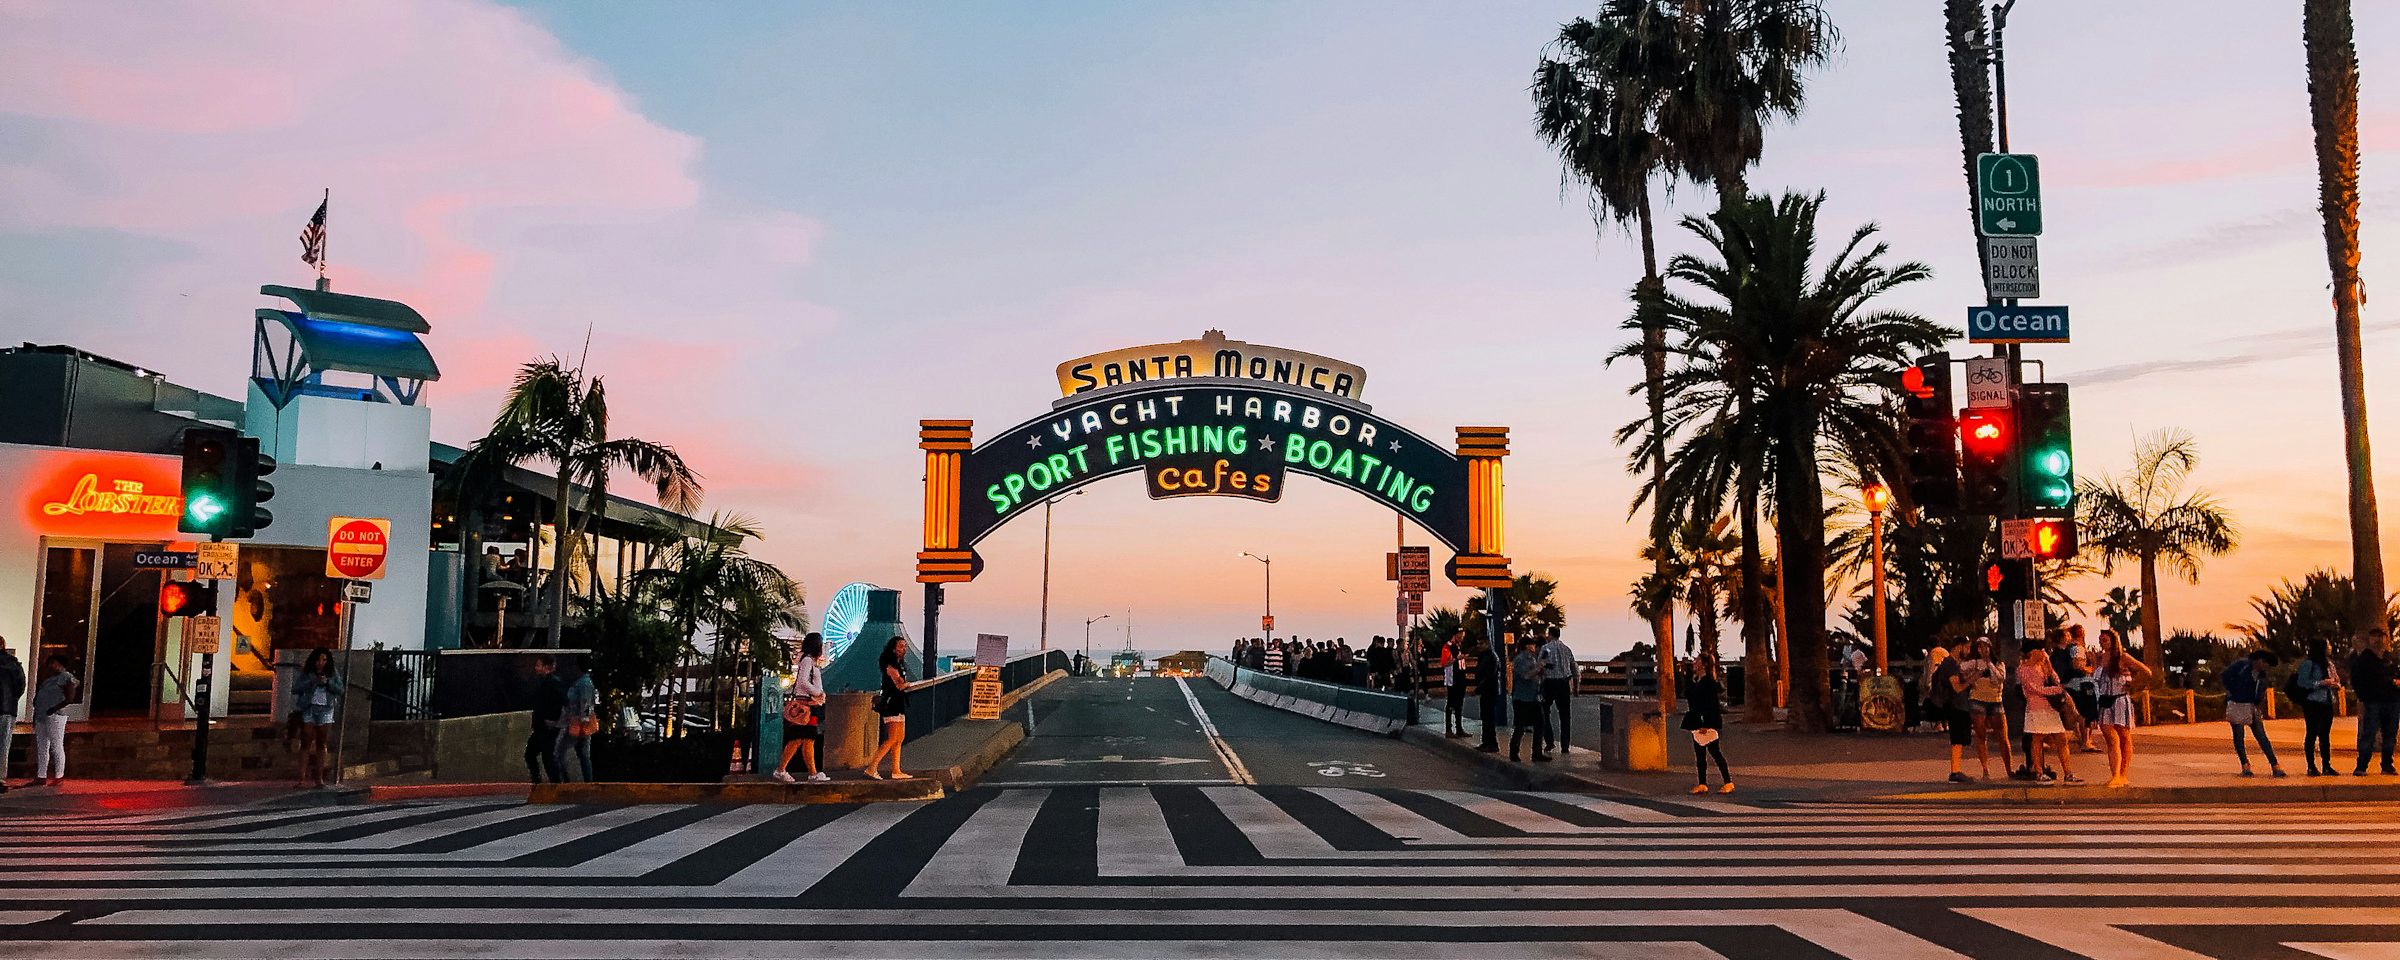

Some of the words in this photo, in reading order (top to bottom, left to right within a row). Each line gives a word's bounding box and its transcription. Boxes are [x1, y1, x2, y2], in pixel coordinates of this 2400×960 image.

[2005, 170, 2012, 187] 1
[1985, 198, 2037, 212] NORTH
[1991, 245, 2008, 259] DO
[2011, 245, 2034, 259] NOT
[1992, 265, 2035, 279] BLOCK
[1992, 282, 2037, 293] INTERSECTION
[1976, 310, 2062, 332] Ocean
[1071, 354, 1193, 394] SANTA
[1214, 349, 1354, 398] MONICA
[1970, 390, 2006, 401] SIGNAL
[1052, 395, 1184, 442] YACHT
[1215, 394, 1378, 447] HARBOR
[986, 443, 1090, 514] SPORT
[1105, 424, 1247, 466] FISHING
[1284, 432, 1436, 515] BOATING
[1157, 458, 1272, 494] cafes
[112, 479, 144, 493] THE
[340, 530, 355, 541] DO
[359, 531, 380, 541] NOT
[2003, 539, 2016, 555] OK
[136, 553, 179, 565] Ocean
[340, 556, 374, 567] ENTER
[199, 561, 213, 575] OK
